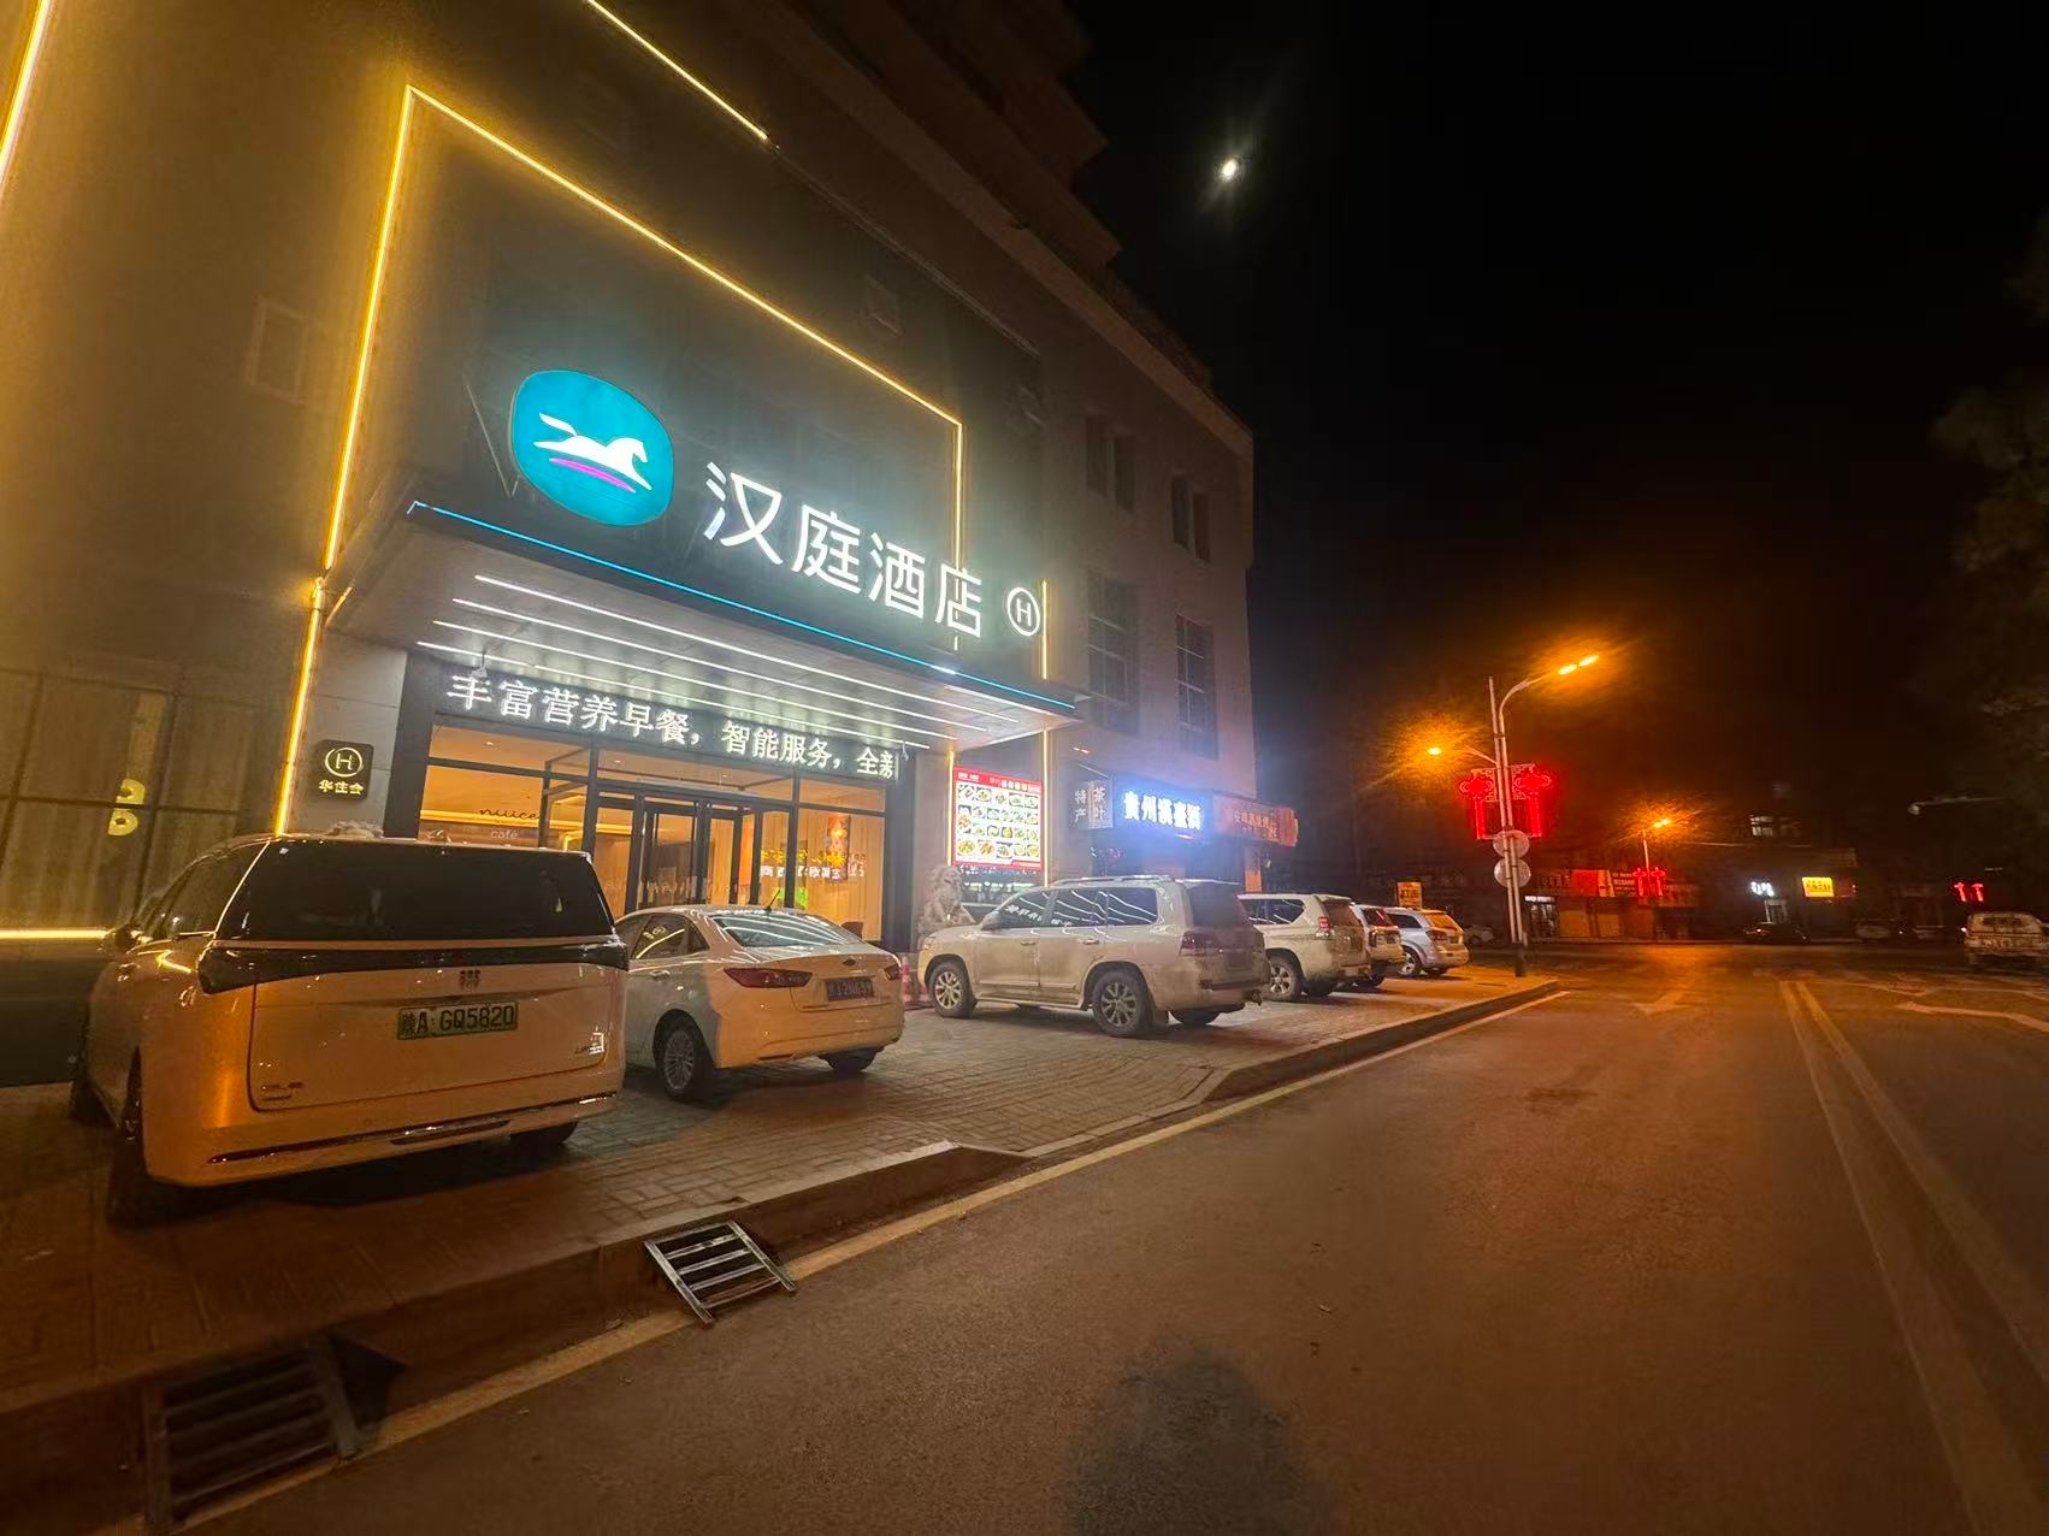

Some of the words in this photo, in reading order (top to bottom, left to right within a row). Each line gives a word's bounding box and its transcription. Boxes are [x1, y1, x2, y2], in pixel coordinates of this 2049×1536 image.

[703, 461, 982, 638] 汉庭酒店
[318, 779, 365, 796] 华住会
